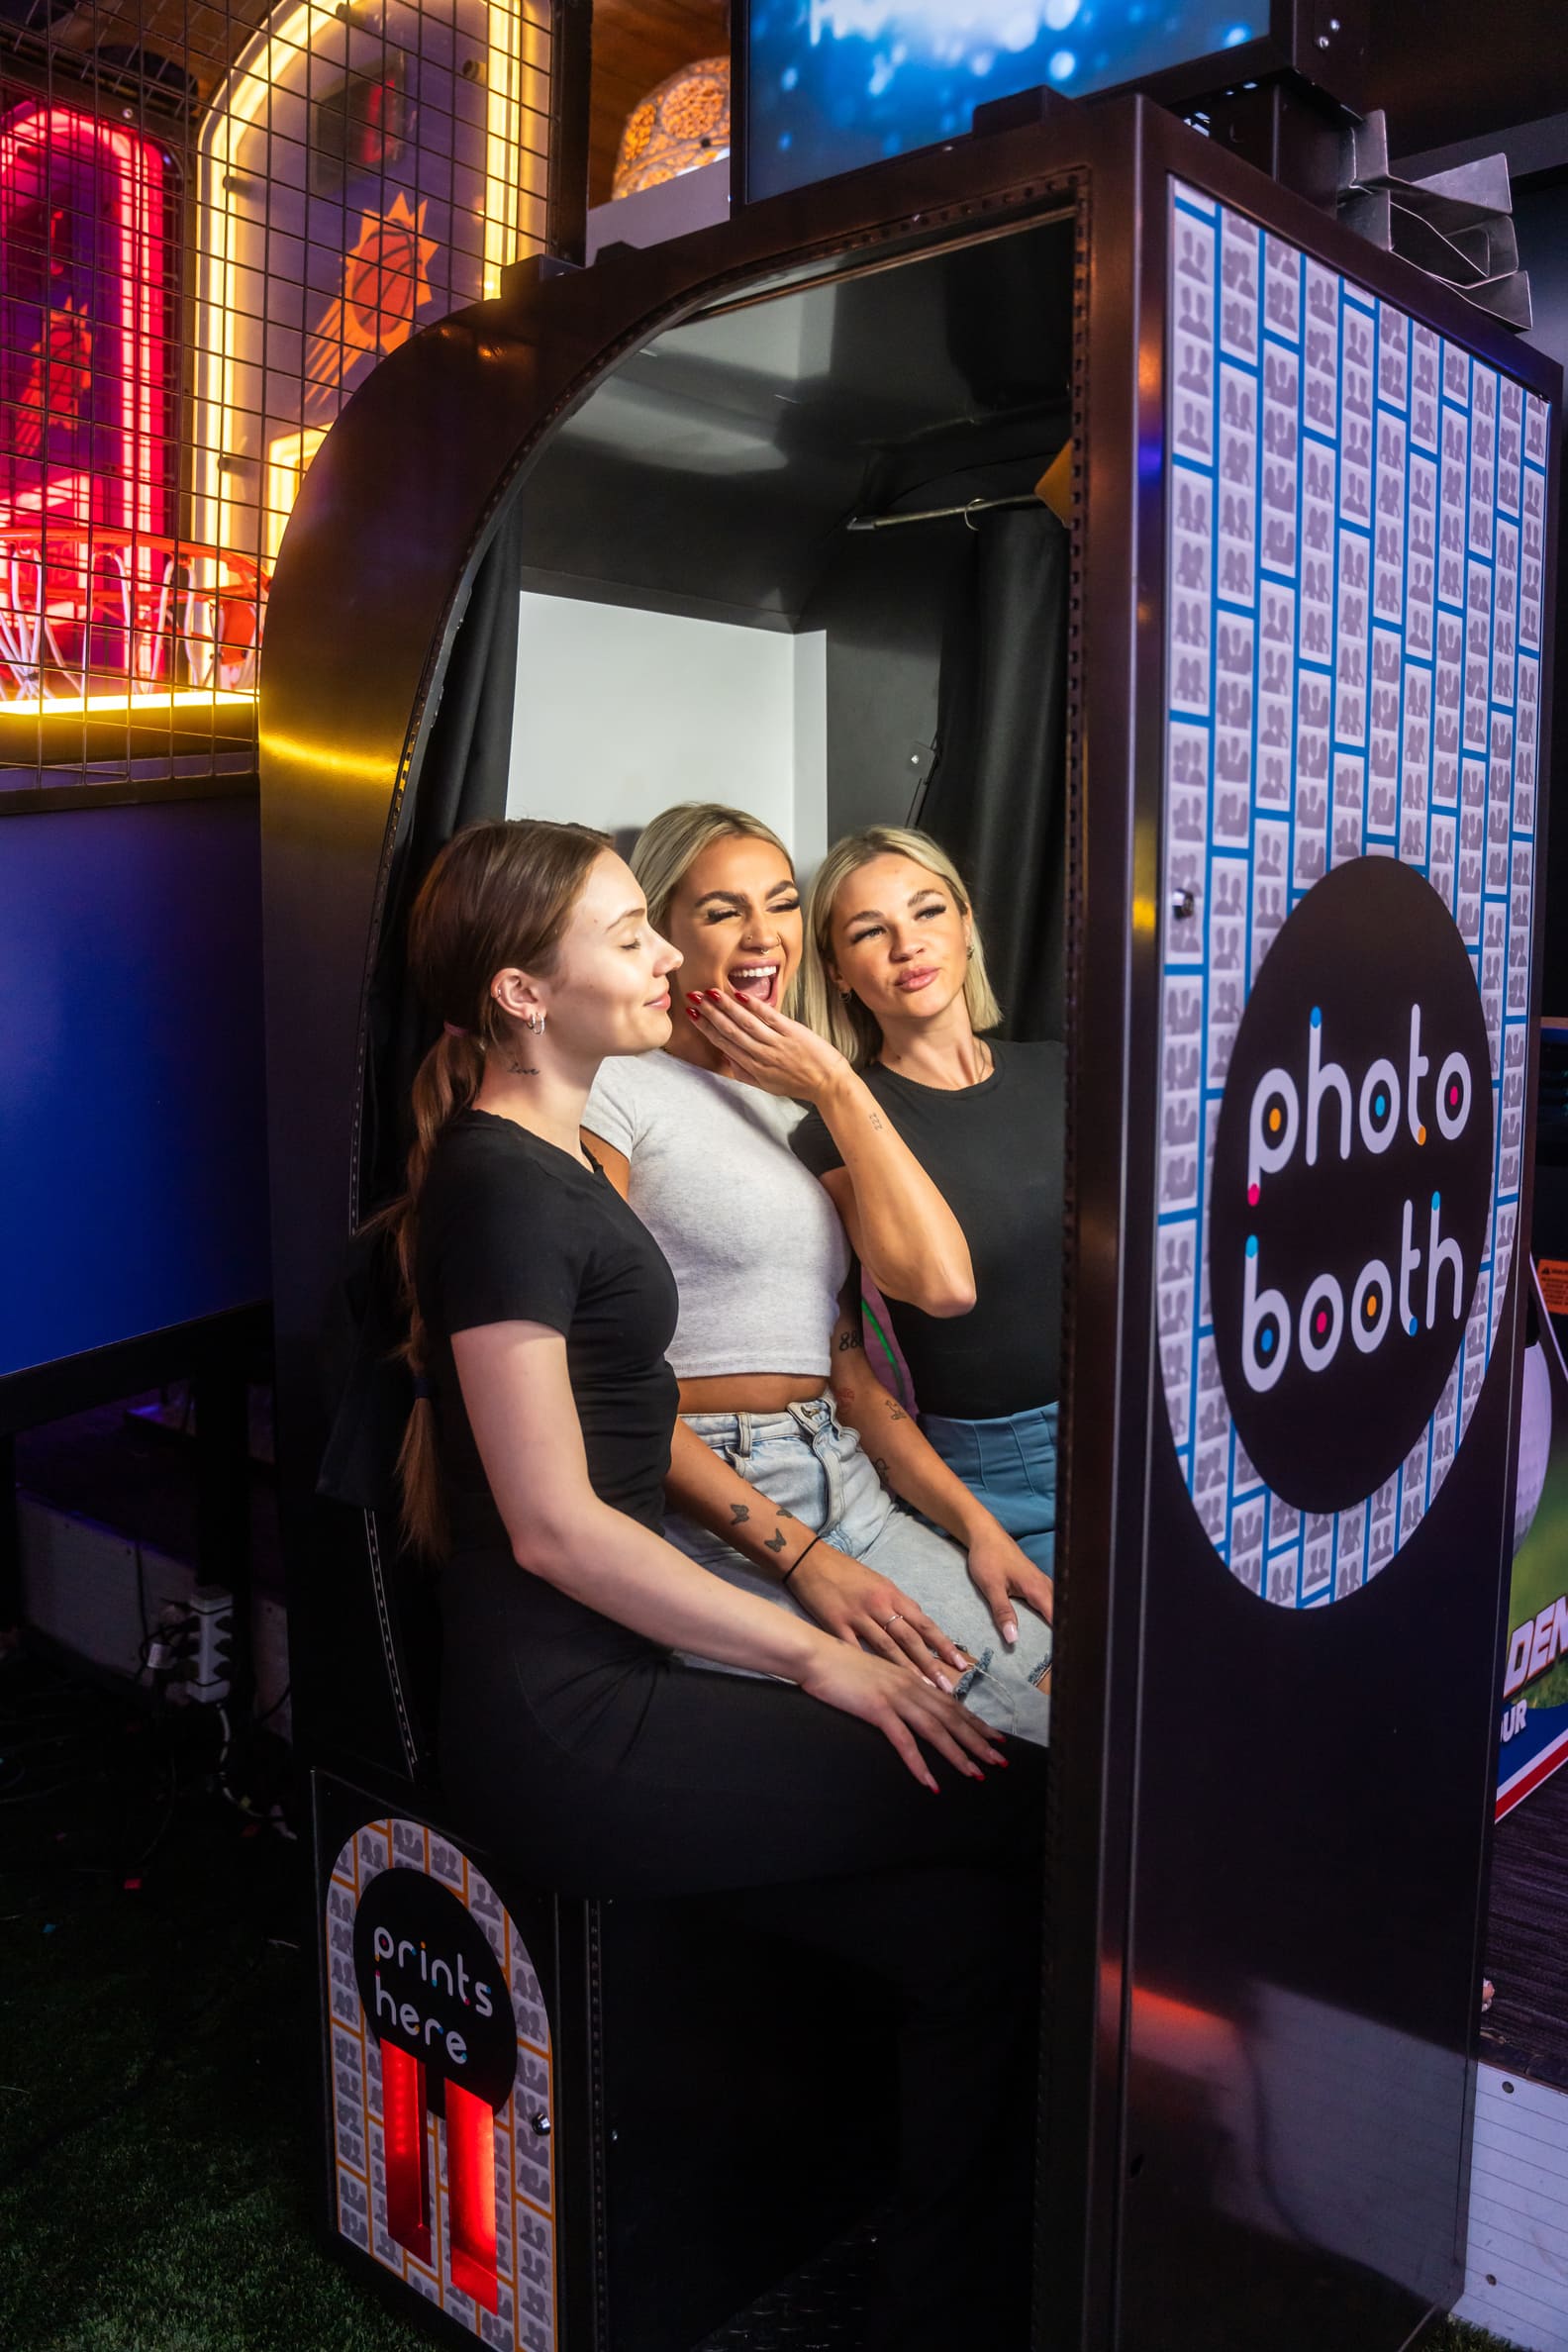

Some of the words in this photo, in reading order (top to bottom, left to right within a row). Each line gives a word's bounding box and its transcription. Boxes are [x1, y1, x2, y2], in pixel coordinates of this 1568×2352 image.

[1247, 1004, 1472, 1206] photo
[1241, 1191, 1464, 1393] booth
[1501, 1699, 1527, 1742] UR
[373, 1926, 493, 2017] prints
[374, 1970, 468, 2065] here
